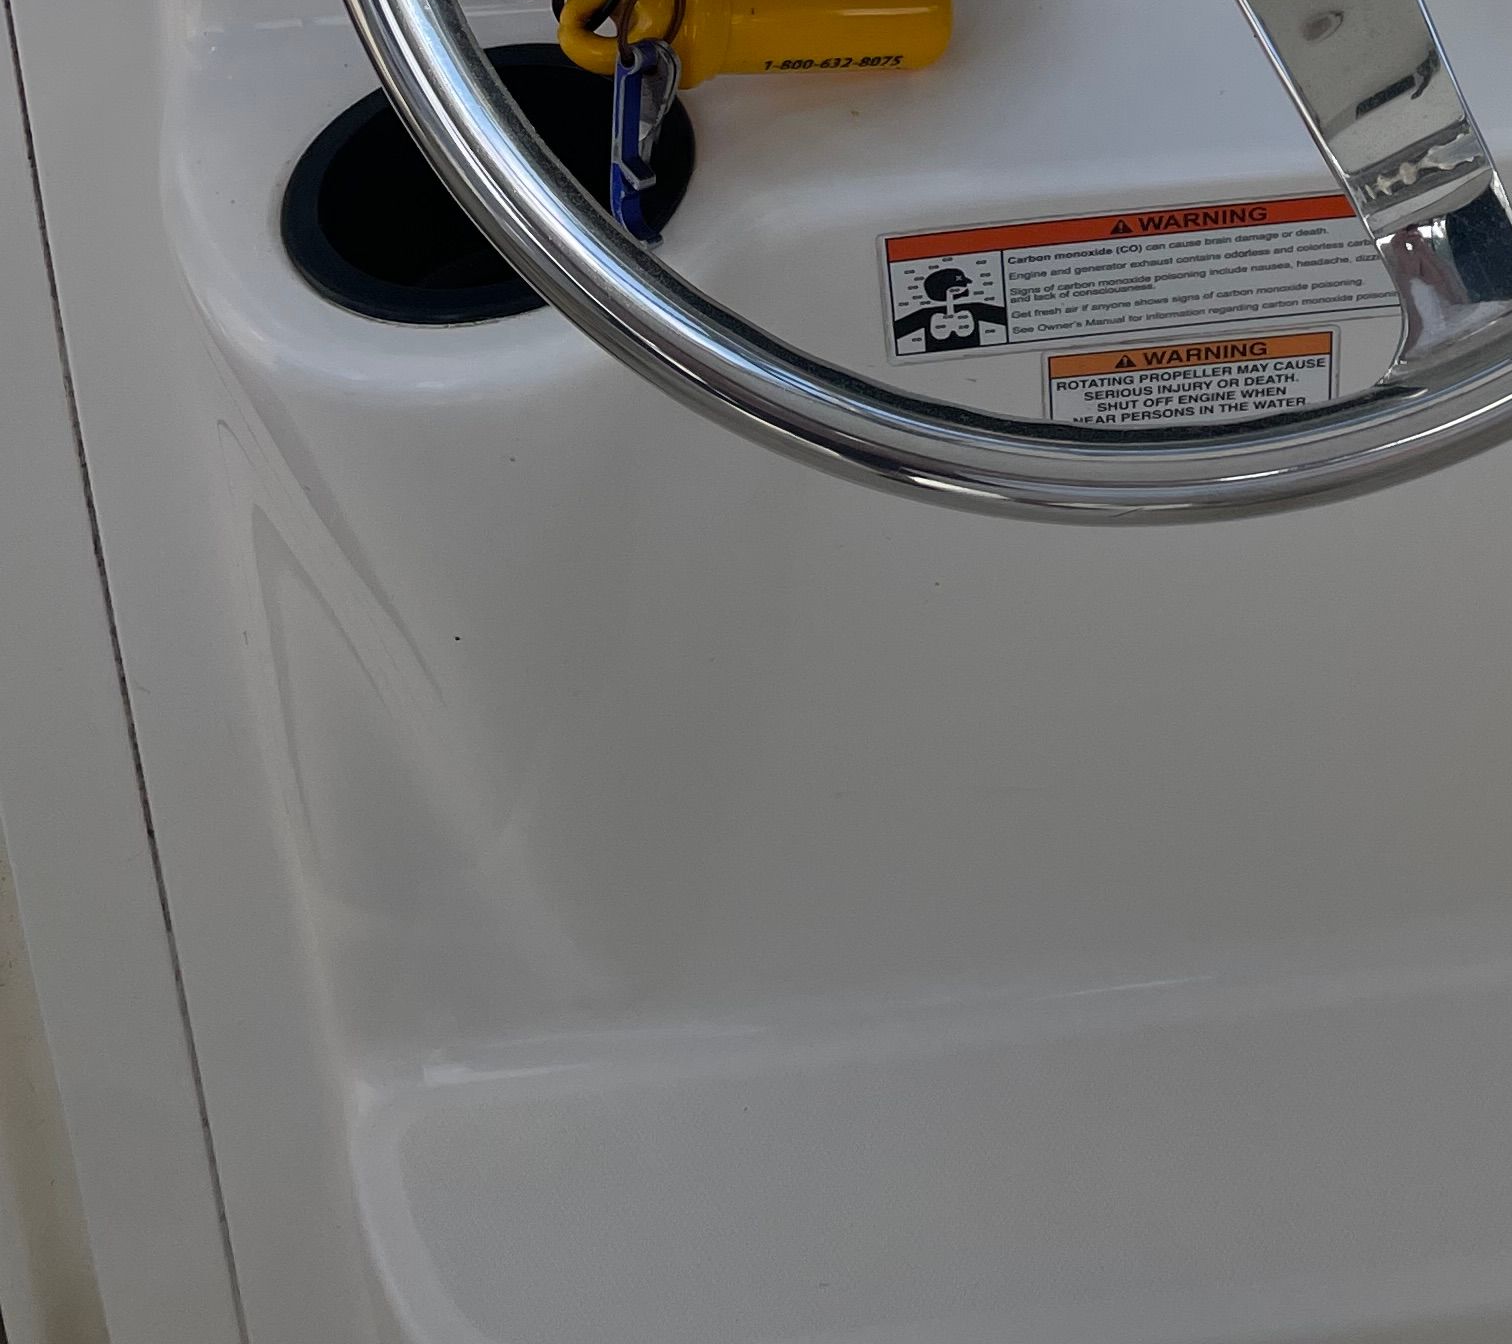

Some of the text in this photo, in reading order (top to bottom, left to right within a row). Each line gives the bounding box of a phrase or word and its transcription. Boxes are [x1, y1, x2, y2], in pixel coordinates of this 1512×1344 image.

[763, 55, 904, 71] 1-800-632-8075
[1138, 206, 1267, 232] WARNING
[1008, 255, 1051, 264] Carbon
[1055, 248, 1113, 260] monoxide
[1116, 245, 1142, 255] (CO)
[1146, 243, 1165, 251] can
[1169, 239, 1201, 248] cause
[1205, 235, 1232, 246] brain
[1235, 232, 1279, 243] damage
[1295, 227, 1329, 237] death.
[1009, 270, 1047, 280] Engine
[1050, 267, 1071, 276] and
[1075, 263, 1126, 275] generator
[1130, 257, 1173, 268] exhaust
[1176, 252, 1221, 264] contains
[1224, 248, 1271, 259] odorless
[1274, 245, 1293, 255] and
[1297, 241, 1344, 252] colorless
[1010, 288, 1041, 297] Signs
[1044, 282, 1054, 291] of
[1058, 280, 1095, 290] carbon
[1098, 276, 1151, 286] monoxide
[1154, 270, 1206, 282] poisoning
[1209, 266, 1248, 276] include
[1251, 262, 1293, 272] nausea,
[1216, 288, 1253, 298] carbon
[1085, 316, 1126, 326] Manual
[1262, 299, 1299, 309] carbon
[1144, 341, 1268, 367] WARNING
[1056, 357, 1326, 391] ROTATING PROPELLER MAY CAUSE
[1084, 373, 1299, 401] SERIOUS INJURY OR DEATH.
[1097, 386, 1287, 412] SHUT OFF ENGINE WHEN
[1122, 407, 1195, 422] PERSONS
[1200, 404, 1214, 414] IN
[1219, 401, 1249, 412] THE
